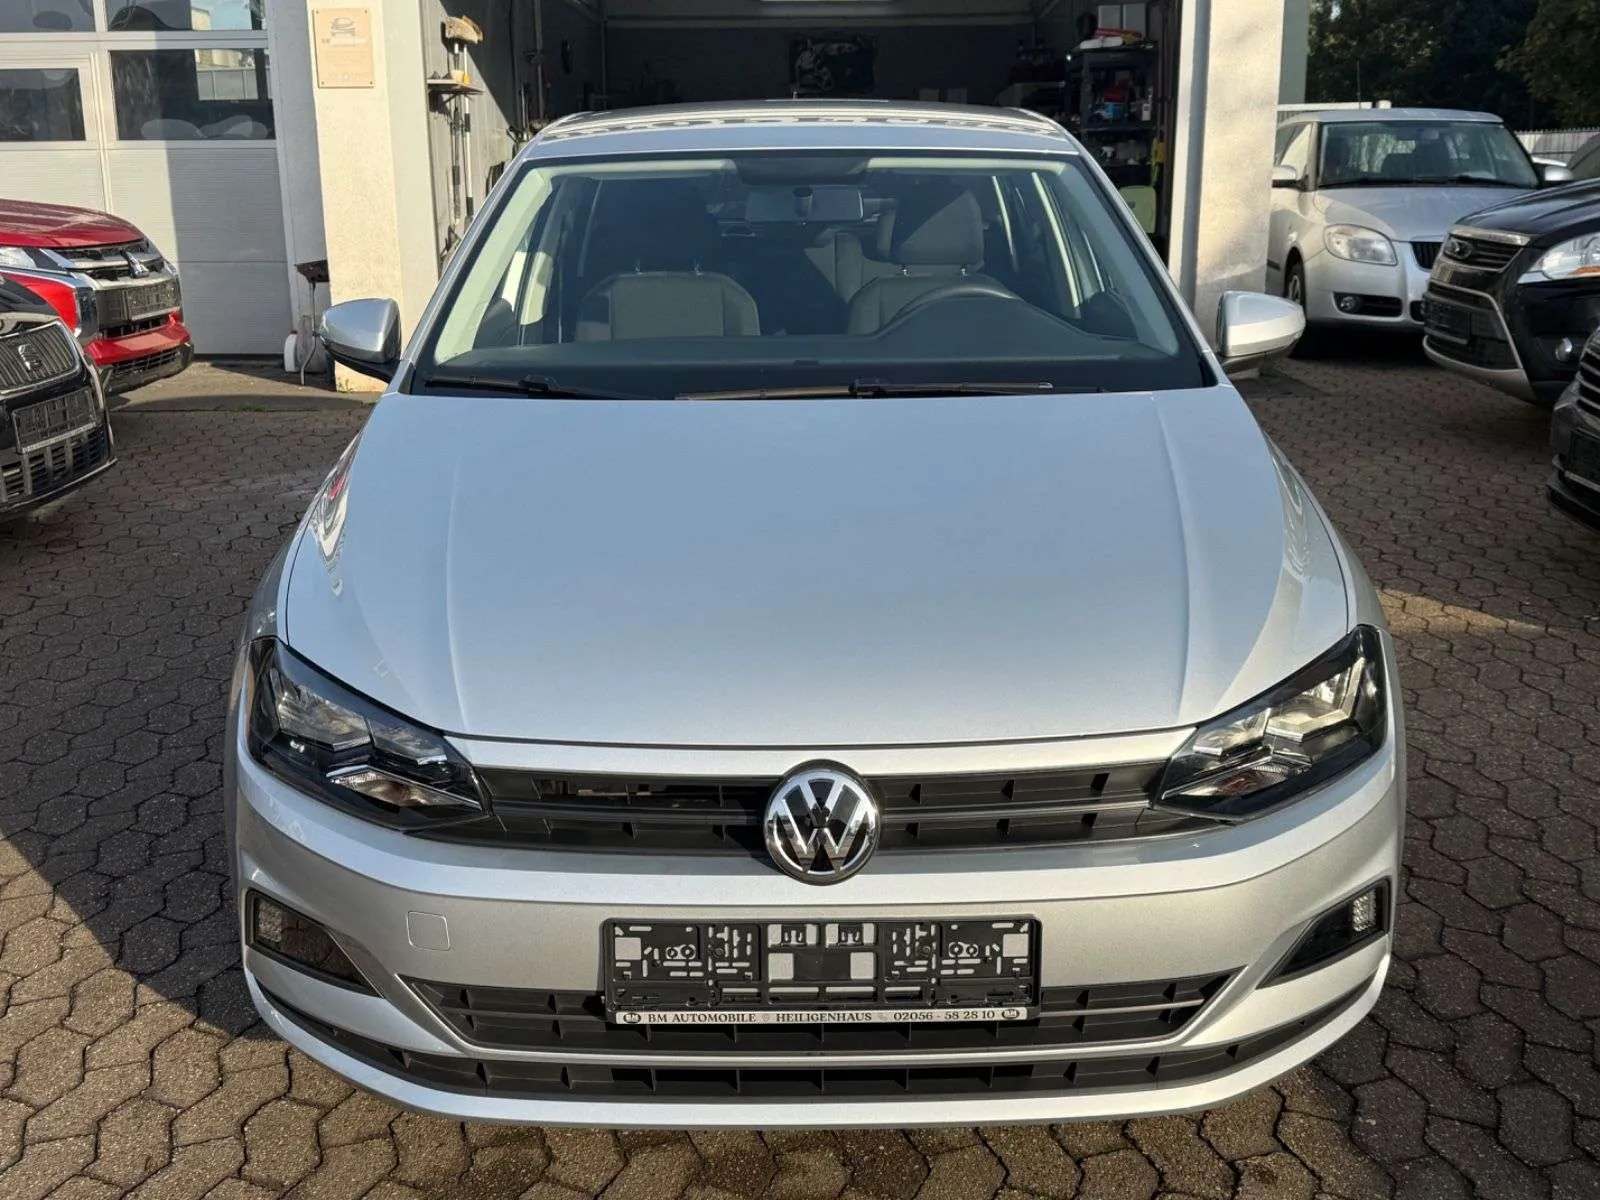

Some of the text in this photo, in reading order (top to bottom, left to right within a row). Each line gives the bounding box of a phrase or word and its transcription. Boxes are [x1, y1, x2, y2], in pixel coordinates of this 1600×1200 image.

[768, 769, 878, 876] VW
[649, 1013, 668, 1023] BM
[672, 1012, 757, 1023] AUTOMOBILE
[775, 1012, 873, 1022] HEILIGENHAUS
[893, 1012, 933, 1021] 02056
[944, 1011, 960, 1020] 58
[963, 1011, 979, 1020] 28
[982, 1010, 995, 1019] 10
